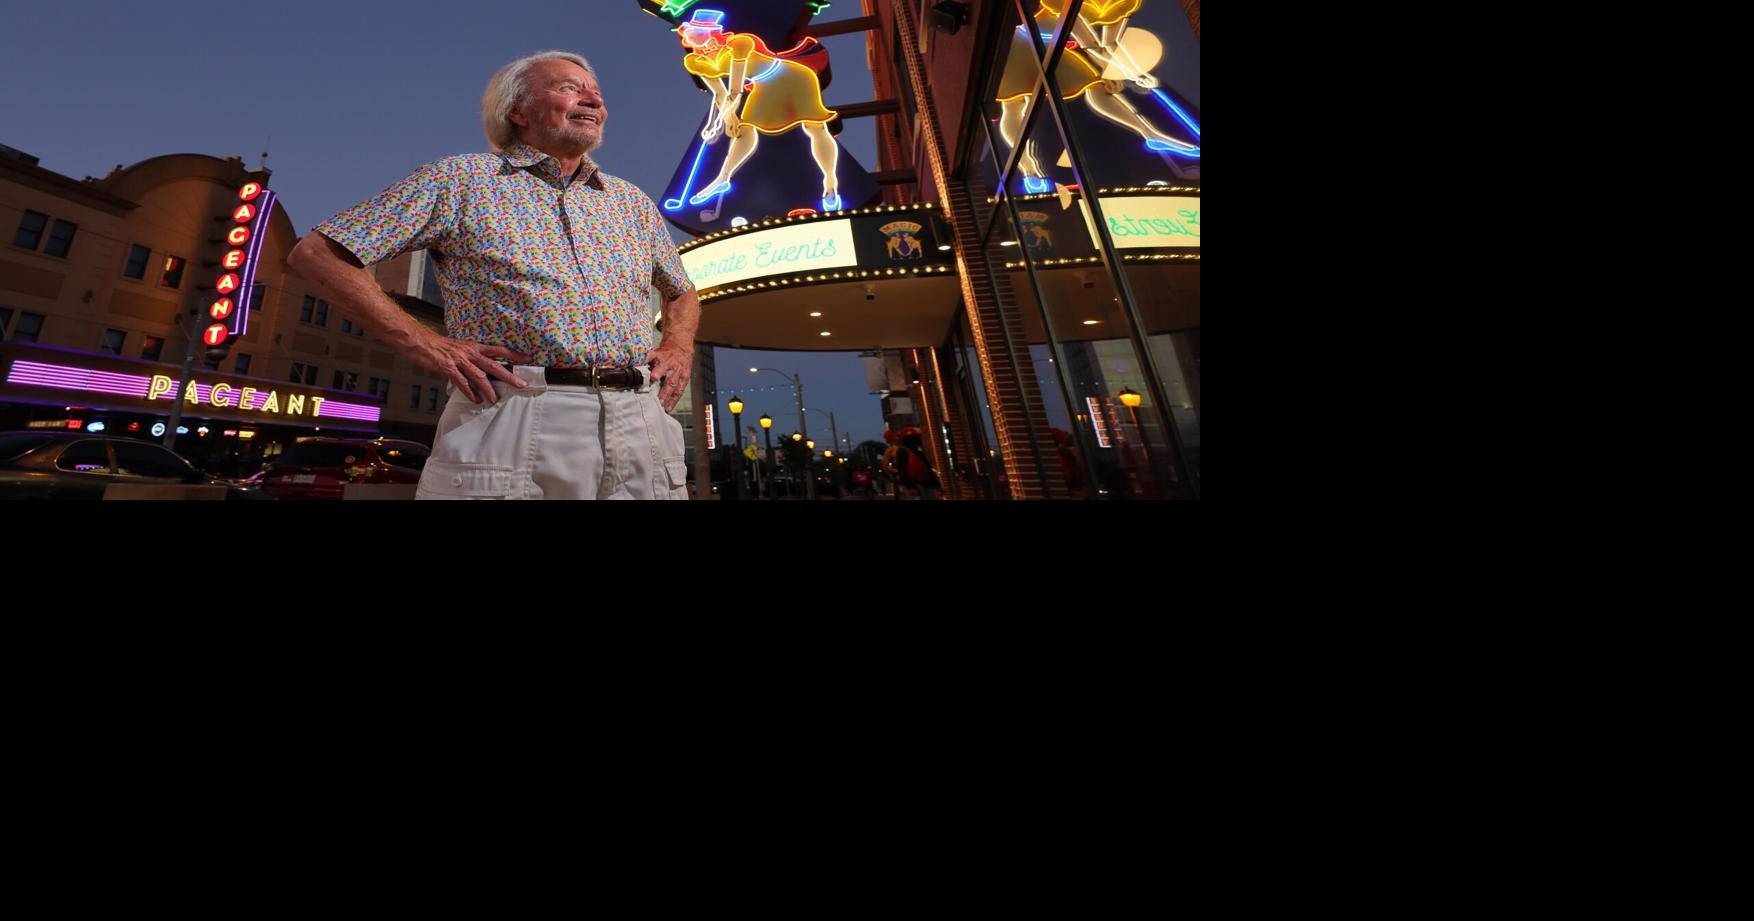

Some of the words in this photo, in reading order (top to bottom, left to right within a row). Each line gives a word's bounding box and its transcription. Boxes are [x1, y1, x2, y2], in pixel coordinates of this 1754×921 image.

[207, 183, 257, 344] PAGEANT
[686, 252, 748, 282] porate
[754, 237, 837, 268] Events
[148, 375, 325, 417] PAGEANT
